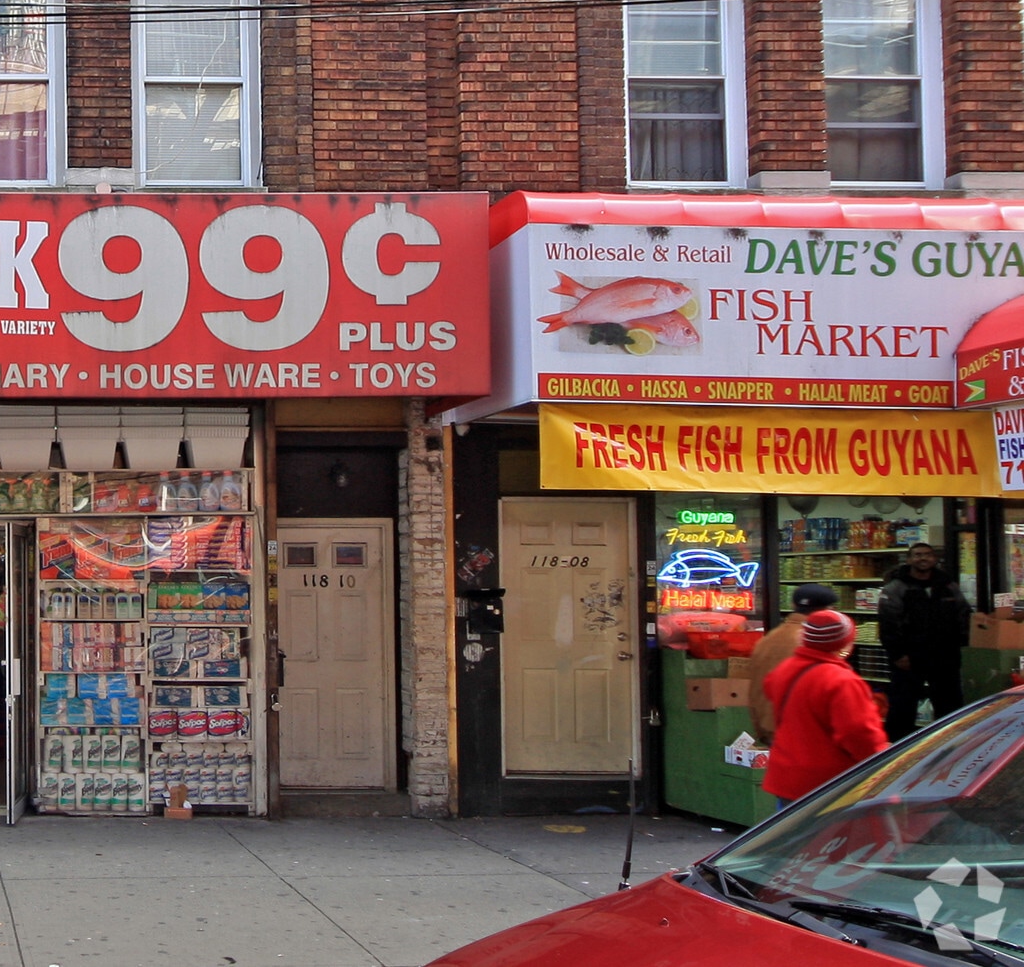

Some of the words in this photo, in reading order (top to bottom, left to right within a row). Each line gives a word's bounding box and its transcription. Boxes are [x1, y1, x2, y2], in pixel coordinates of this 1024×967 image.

[545, 242, 645, 262] Wholesale
[653, 244, 669, 262] &
[677, 244, 732, 264] Retail
[744, 237, 897, 276] DAVE'S
[58, 202, 440, 352] 99¢
[708, 289, 814, 322] FISH
[0, 320, 56, 336] VARIETY
[339, 321, 457, 352] PLUS
[756, 324, 949, 358] MARKET
[100, 363, 215, 390] HOUSE
[224, 362, 321, 389] WARE
[349, 362, 437, 389] TOYS
[959, 348, 1000, 381] DAVE'S
[547, 377, 621, 397] GILBACKA
[641, 380, 688, 399] HASSA
[708, 381, 774, 401] SNAPPER
[799, 382, 844, 402] HALAL
[848, 384, 888, 403] MEAT
[908, 385, 948, 404] GOAT
[574, 422, 668, 471] FRESH
[677, 425, 745, 475] FISH
[757, 427, 842, 477] FROM
[848, 429, 978, 477] GUYANA
[681, 511, 734, 525] Guyana
[531, 556, 589, 567] 118-08
[666, 590, 706, 607] Halal
[711, 591, 752, 608] Meat
